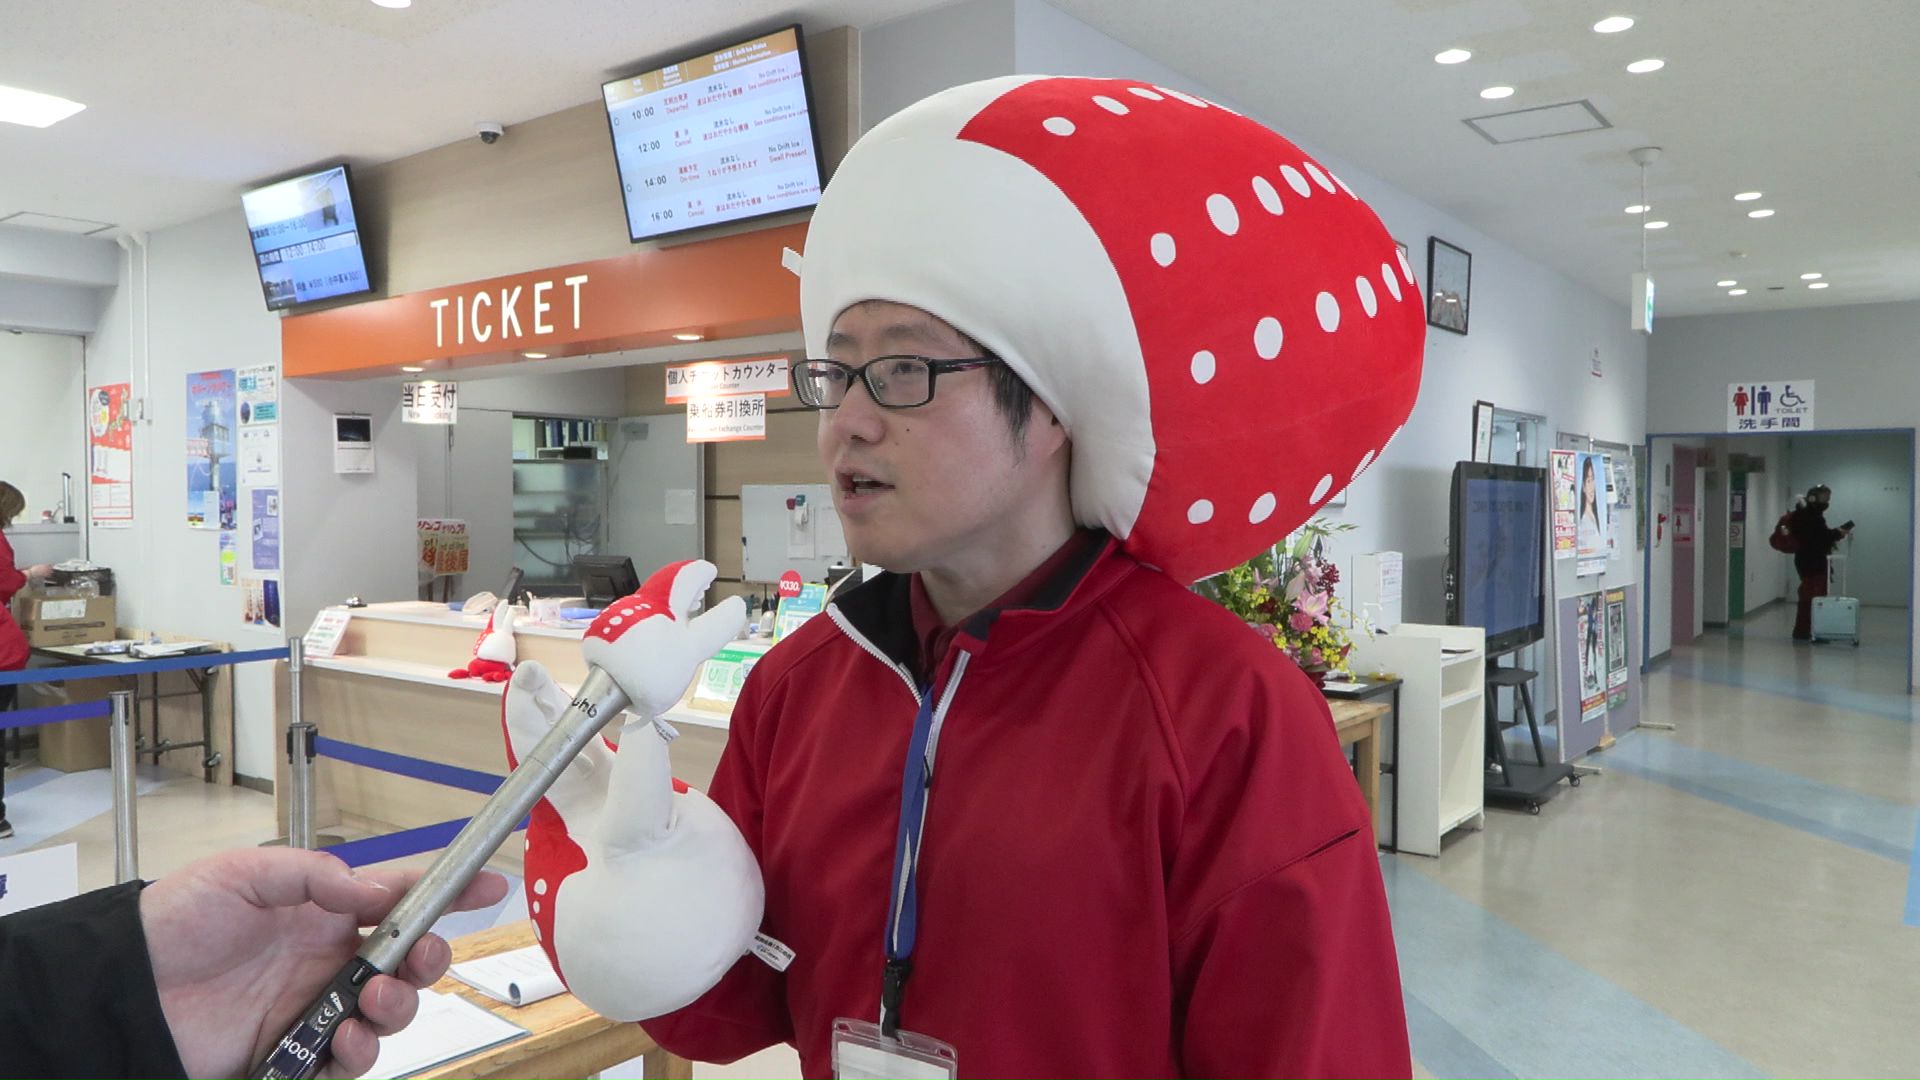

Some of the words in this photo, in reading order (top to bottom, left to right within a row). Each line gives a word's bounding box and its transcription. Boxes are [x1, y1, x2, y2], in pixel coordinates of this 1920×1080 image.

[632, 107, 654, 120] 10:00
[638, 140, 661, 153] 12:00
[645, 175, 667, 188] 14:00
[651, 209, 673, 222] 16:00
[430, 275, 588, 347] TICKET
[668, 362, 787, 385] 個人チットカウンター
[403, 384, 456, 408] 当日受付
[1739, 417, 1800, 429] 洗手間
